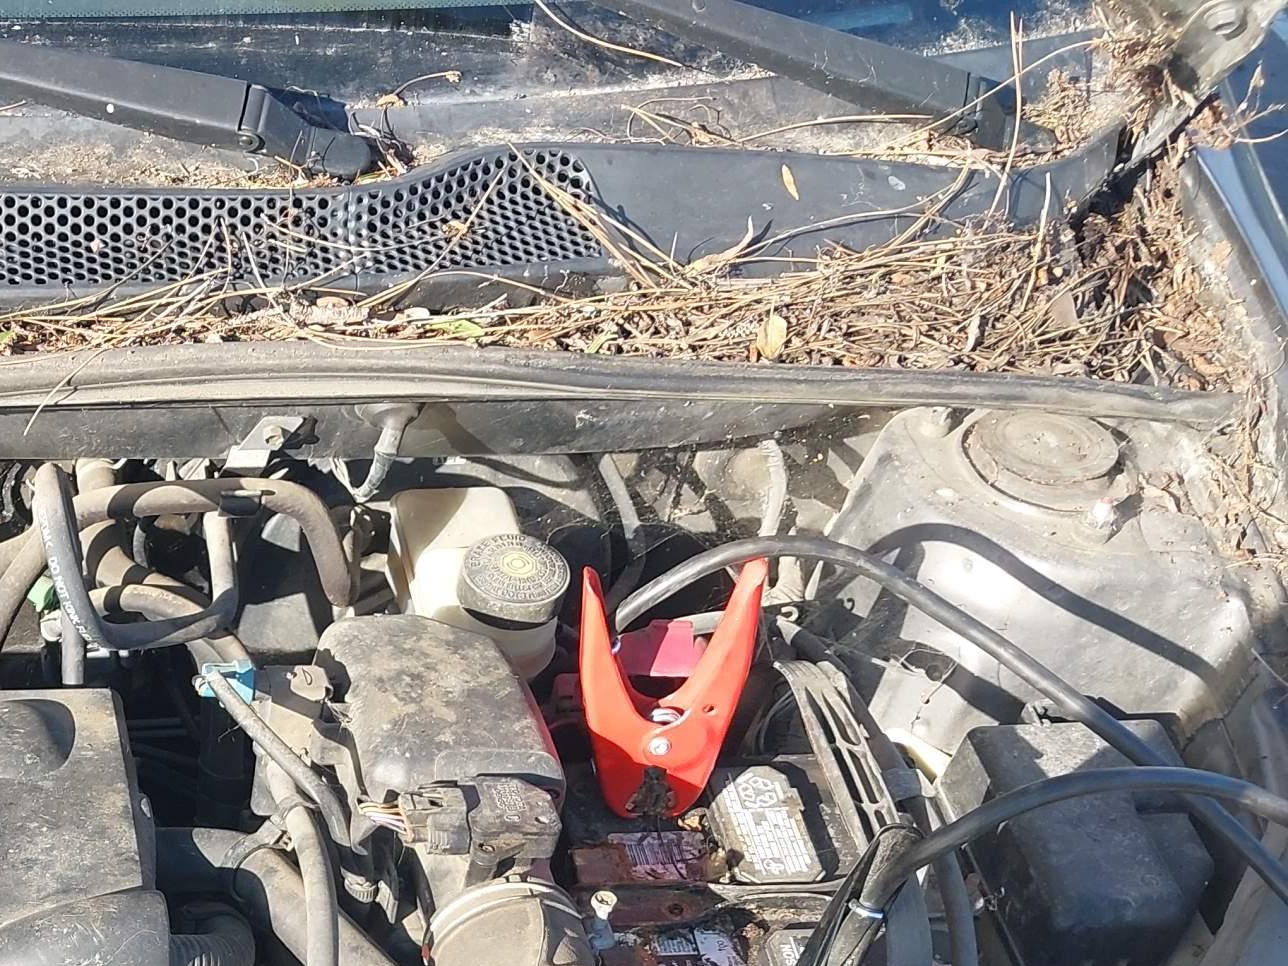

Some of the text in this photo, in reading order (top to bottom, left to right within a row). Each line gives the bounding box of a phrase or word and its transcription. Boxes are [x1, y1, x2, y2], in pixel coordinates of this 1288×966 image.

[48, 556, 59, 574] DO
[54, 575, 69, 599] NOT
[63, 601, 80, 625] KINK
